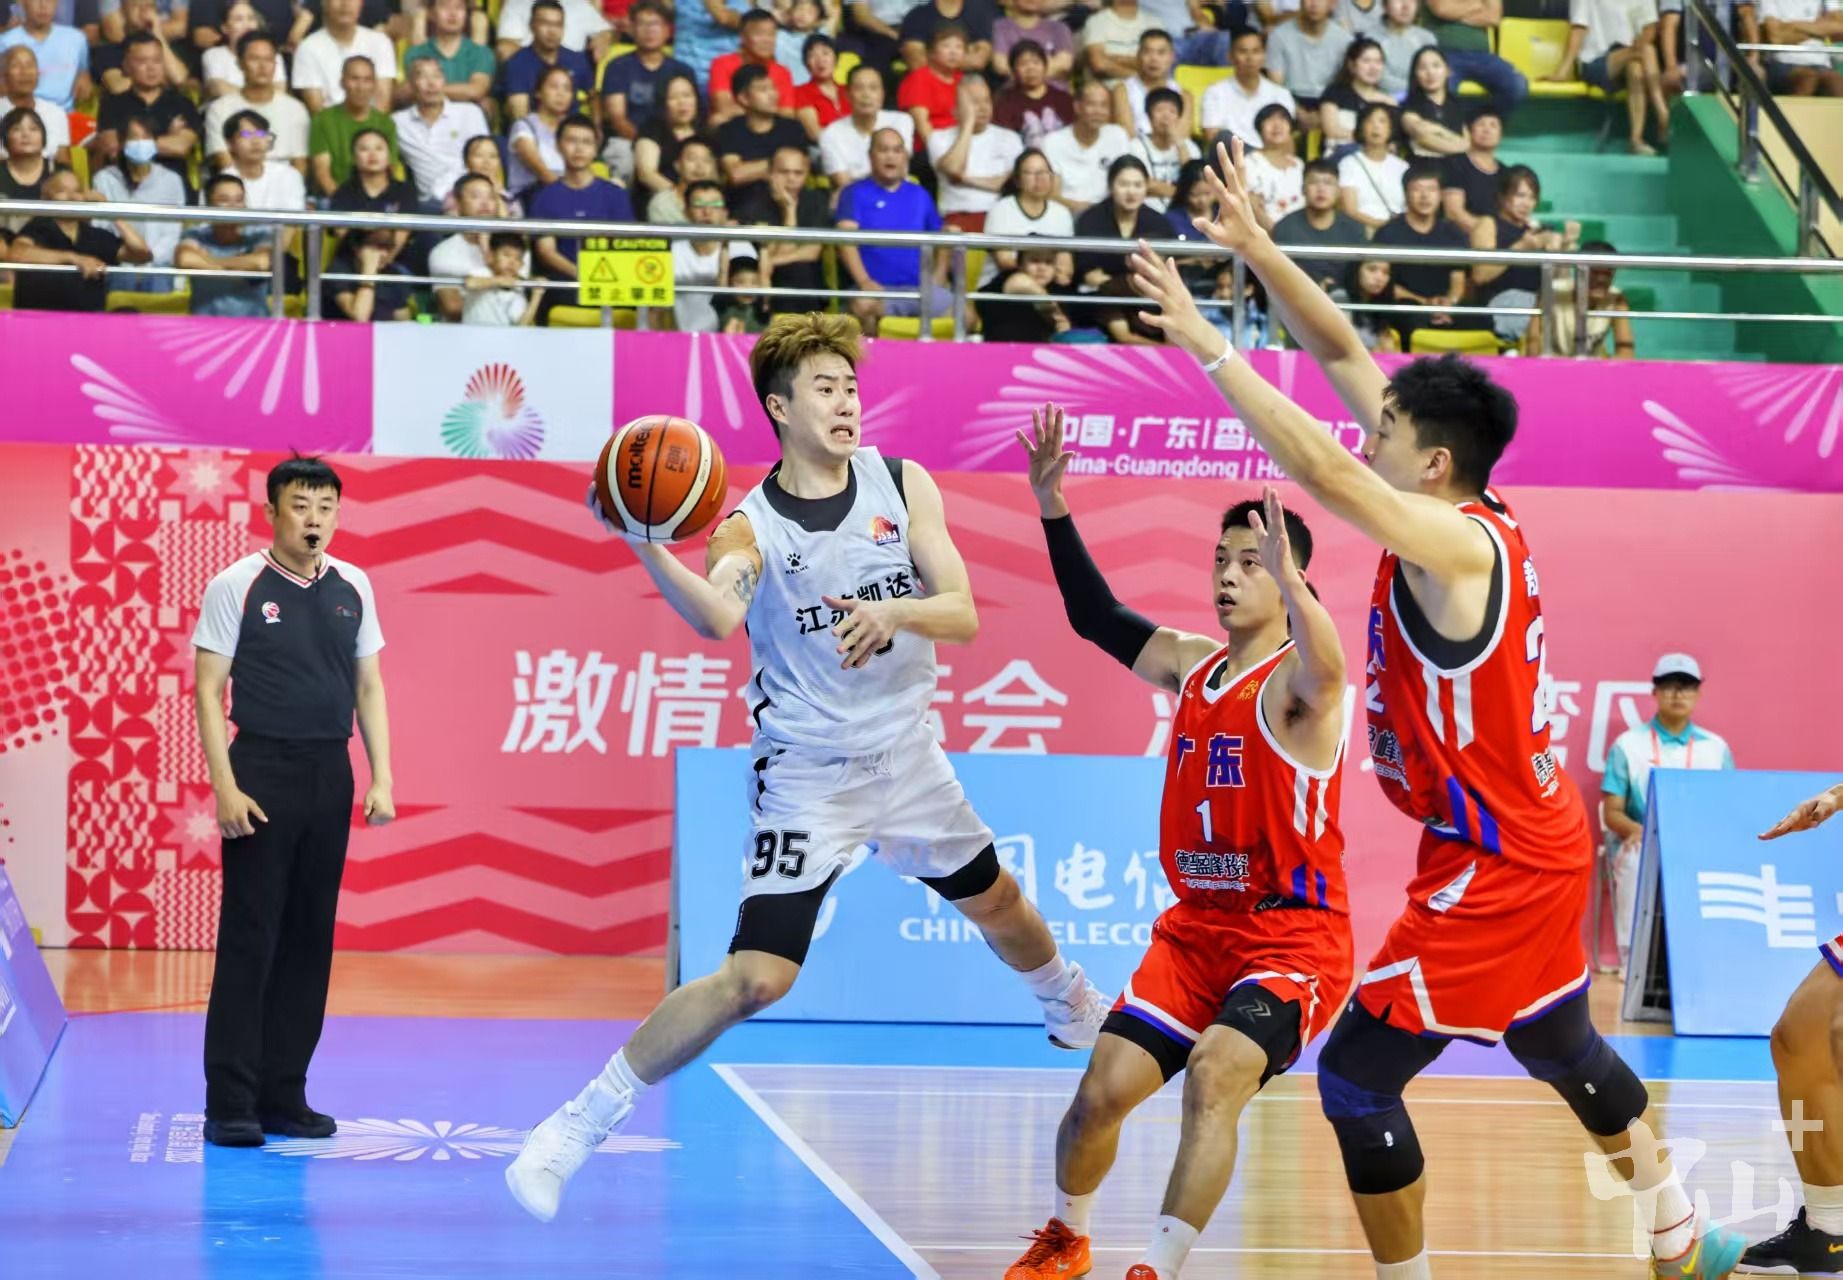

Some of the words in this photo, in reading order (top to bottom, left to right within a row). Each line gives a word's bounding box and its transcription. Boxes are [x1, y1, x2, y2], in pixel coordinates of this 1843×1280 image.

[1196, 799, 1213, 844] 1
[751, 830, 811, 879] 95
[900, 918, 985, 942] CHIN
[1049, 921, 1153, 945] ELECO
